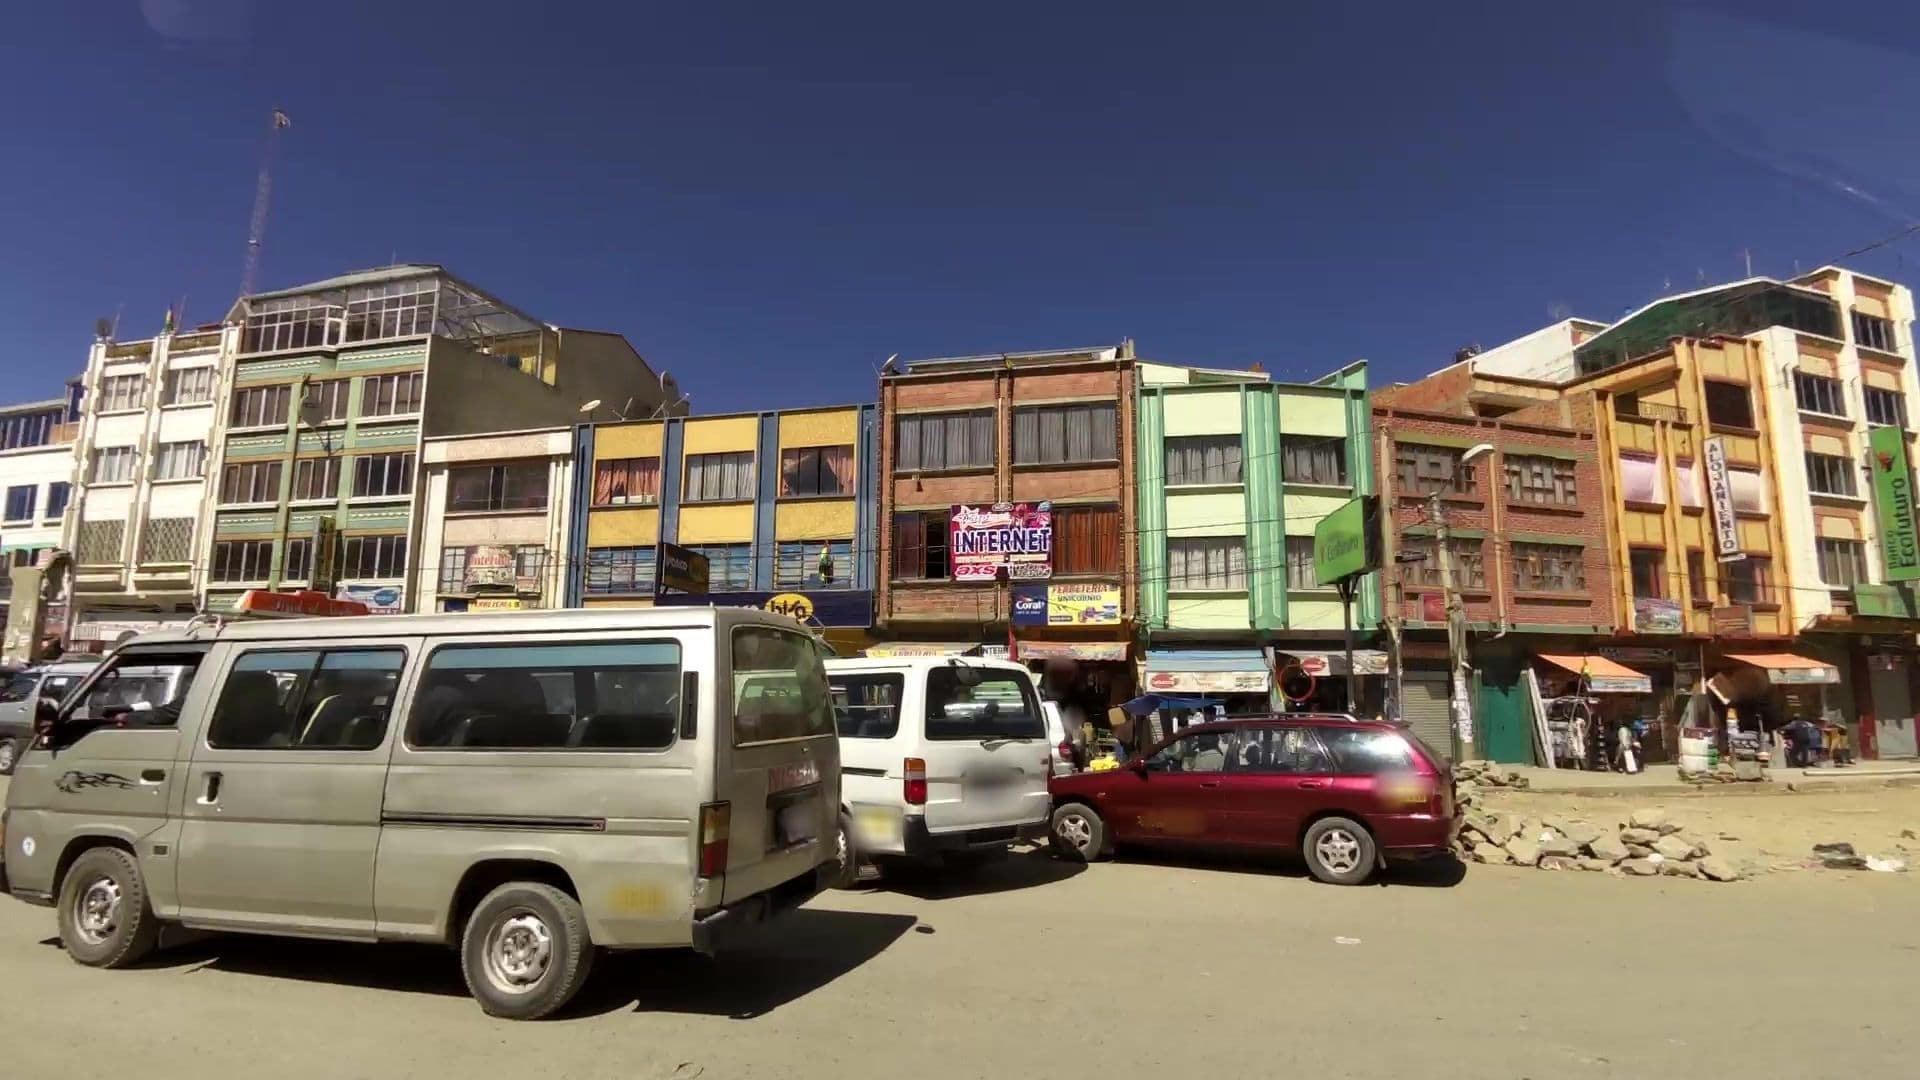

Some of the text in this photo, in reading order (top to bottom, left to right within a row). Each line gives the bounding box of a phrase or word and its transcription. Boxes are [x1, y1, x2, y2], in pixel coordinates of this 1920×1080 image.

[1708, 443, 1735, 549] ALOJAMIENTO
[954, 527, 1051, 554] INTERNET
[1015, 600, 1041, 610] Coral
